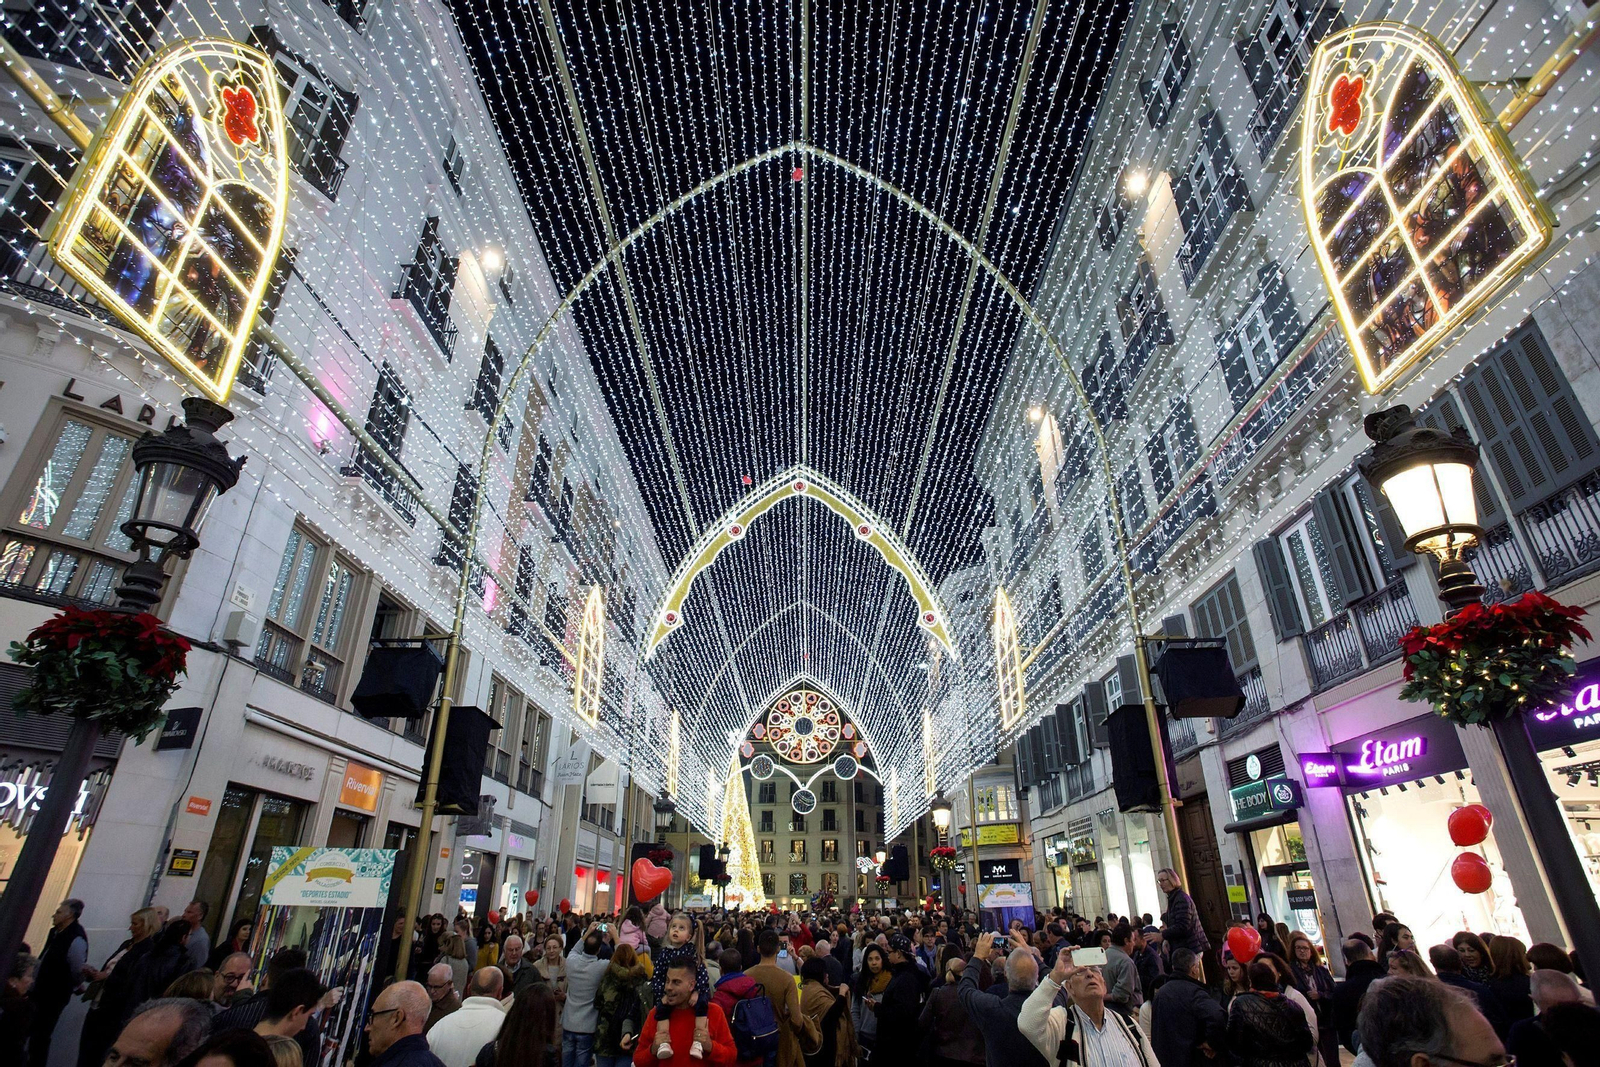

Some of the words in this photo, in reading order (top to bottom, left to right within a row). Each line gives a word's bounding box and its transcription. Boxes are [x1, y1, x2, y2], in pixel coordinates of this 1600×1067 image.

[1360, 736, 1421, 770] Etam
[558, 761, 585, 771] LARIOS
[1304, 761, 1336, 775] Etam
[1382, 762, 1410, 777] PARIS
[1247, 791, 1268, 808] BODY
